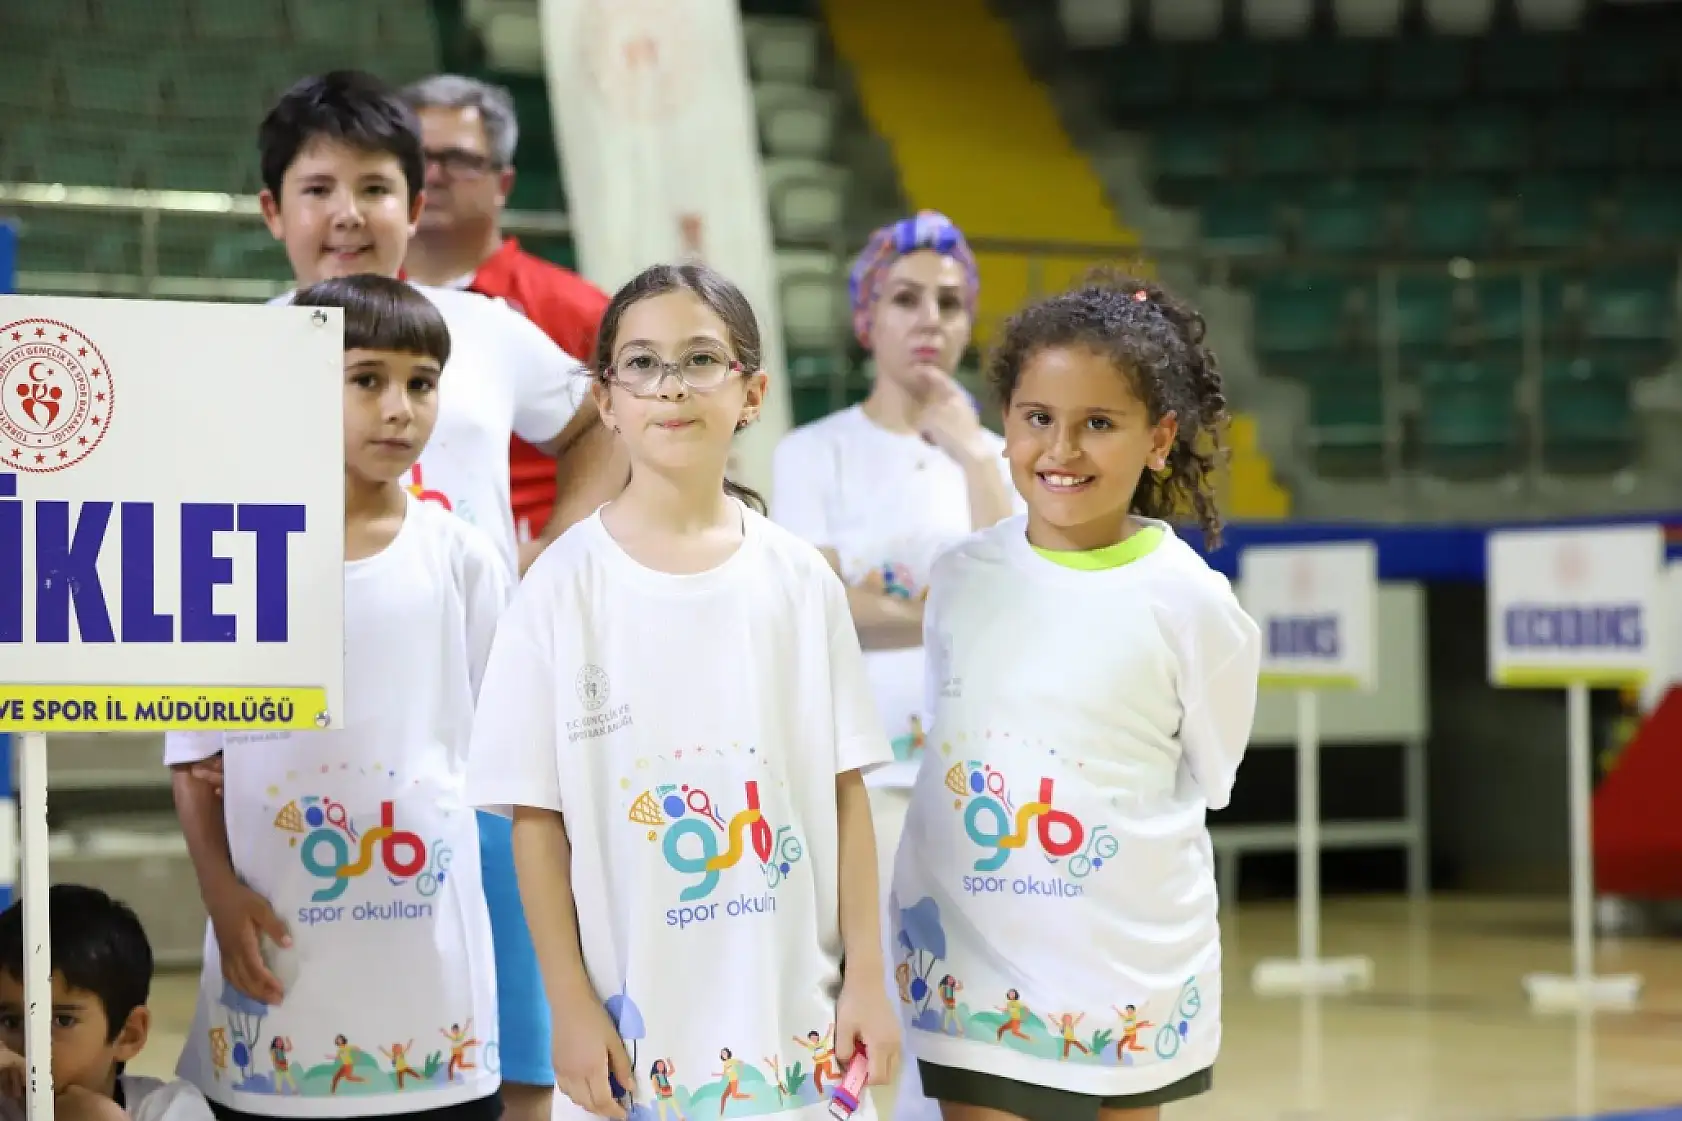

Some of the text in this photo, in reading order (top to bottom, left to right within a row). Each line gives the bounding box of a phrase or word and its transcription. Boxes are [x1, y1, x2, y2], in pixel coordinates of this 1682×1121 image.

[0, 473, 306, 643] İKLET
[32, 700, 98, 721] SPOR
[106, 695, 127, 721] İL
[135, 695, 294, 722] MÜDÜRLÜĞÜ
[963, 777, 1084, 871] gsb
[300, 801, 426, 902] gsb
[962, 875, 1007, 895] spor
[298, 906, 345, 926] spor
[666, 902, 719, 928] spor
